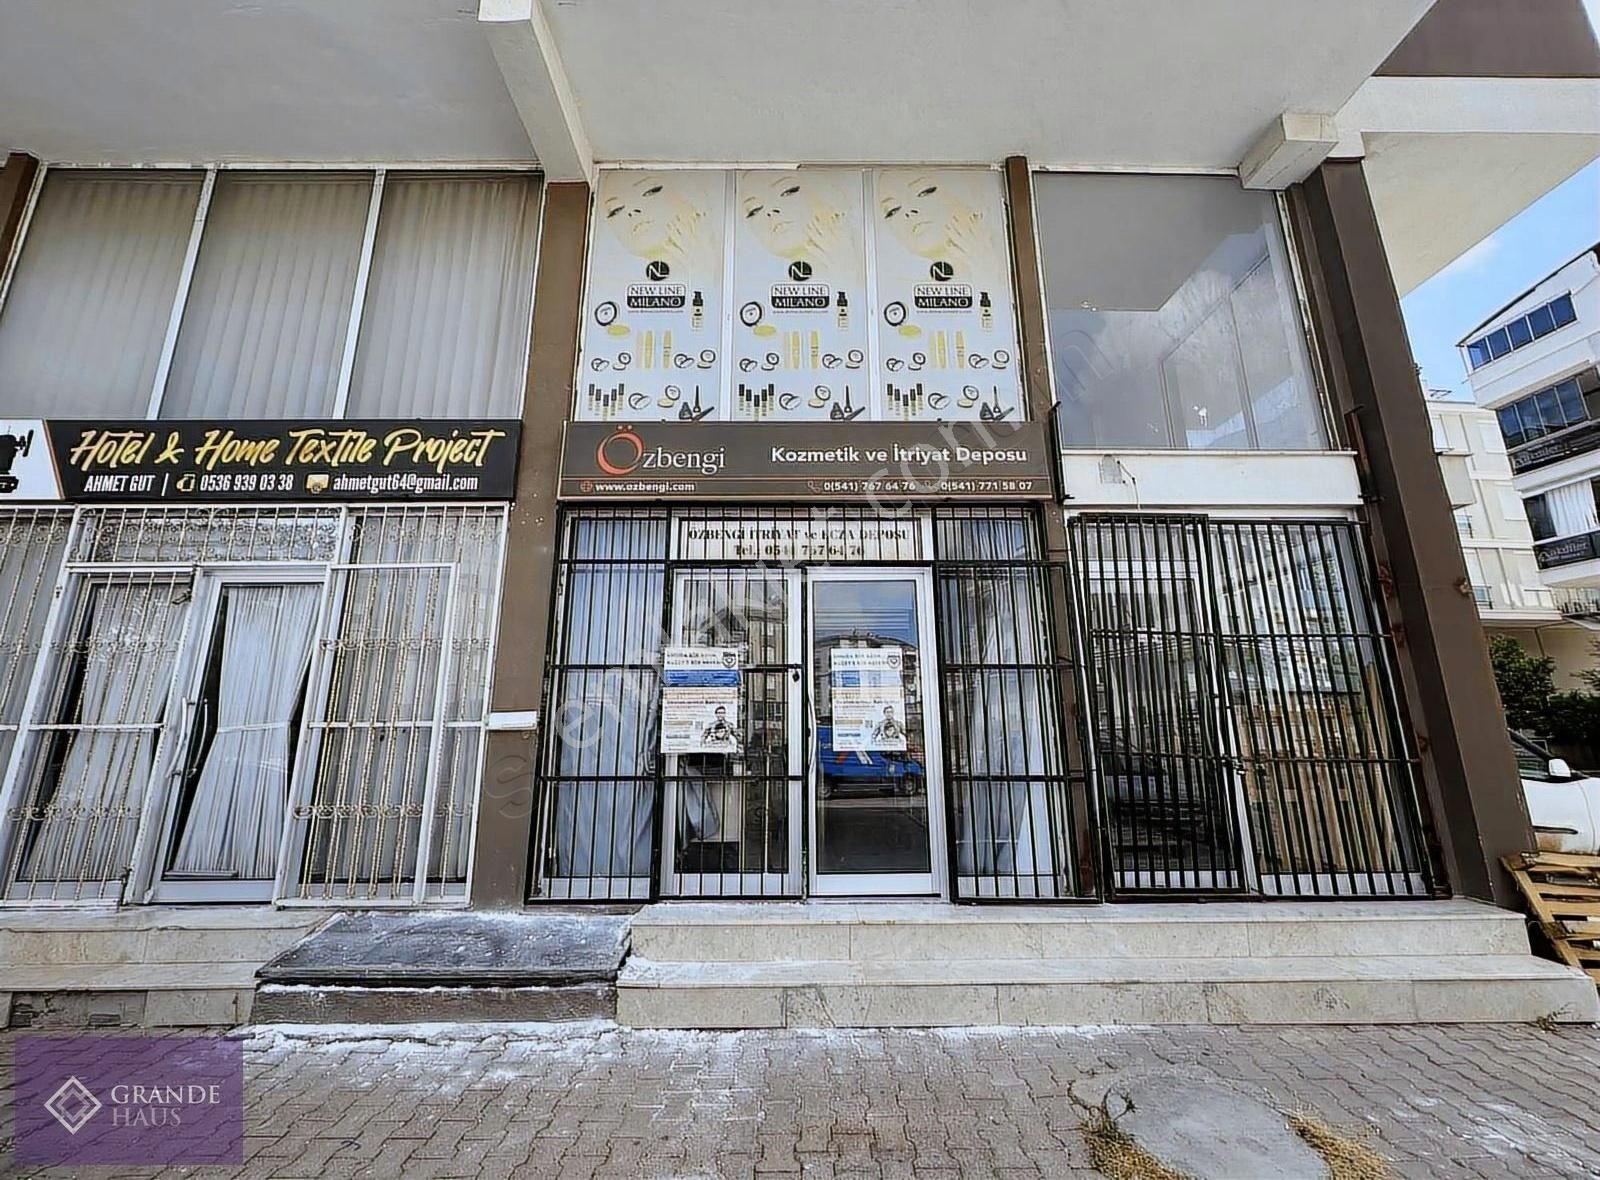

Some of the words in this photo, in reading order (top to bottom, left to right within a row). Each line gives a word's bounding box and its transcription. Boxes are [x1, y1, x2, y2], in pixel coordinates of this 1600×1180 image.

[630, 286, 656, 296] NEW
[658, 286, 683, 296] LINE
[773, 286, 799, 296] NEW
[802, 286, 826, 296] LINE
[916, 286, 942, 296] NEW
[945, 286, 969, 296] LINE
[629, 297, 682, 307] MILANO
[773, 297, 826, 307] MILANO
[917, 297, 969, 307] MILANO
[70, 430, 155, 471] Hotel
[154, 431, 185, 464] &
[195, 430, 281, 471] Home
[285, 428, 377, 467] Textile
[383, 428, 506, 474] Project
[596, 425, 726, 475] Özbengi
[771, 447, 860, 463] Kozmetik
[868, 450, 888, 462] ve
[893, 443, 951, 465] İtriyat
[956, 447, 1027, 465] Deposu
[84, 475, 129, 492] AHMET
[130, 475, 156, 492] GUT
[200, 474, 230, 492] 0536
[233, 474, 257, 492] 939
[259, 474, 274, 492] 03
[277, 474, 294, 492] 38
[333, 474, 478, 494] ahmetgut64@gmail.com
[594, 482, 695, 493] www.ozbengi.com
[823, 481, 858, 492] 0(541)
[861, 481, 882, 491] 767
[885, 481, 899, 491] 64
[901, 481, 916, 491] 76
[941, 481, 976, 492] 0(541)
[979, 481, 999, 491] 771
[1002, 481, 1016, 491] 58
[1018, 481, 1033, 491] 07
